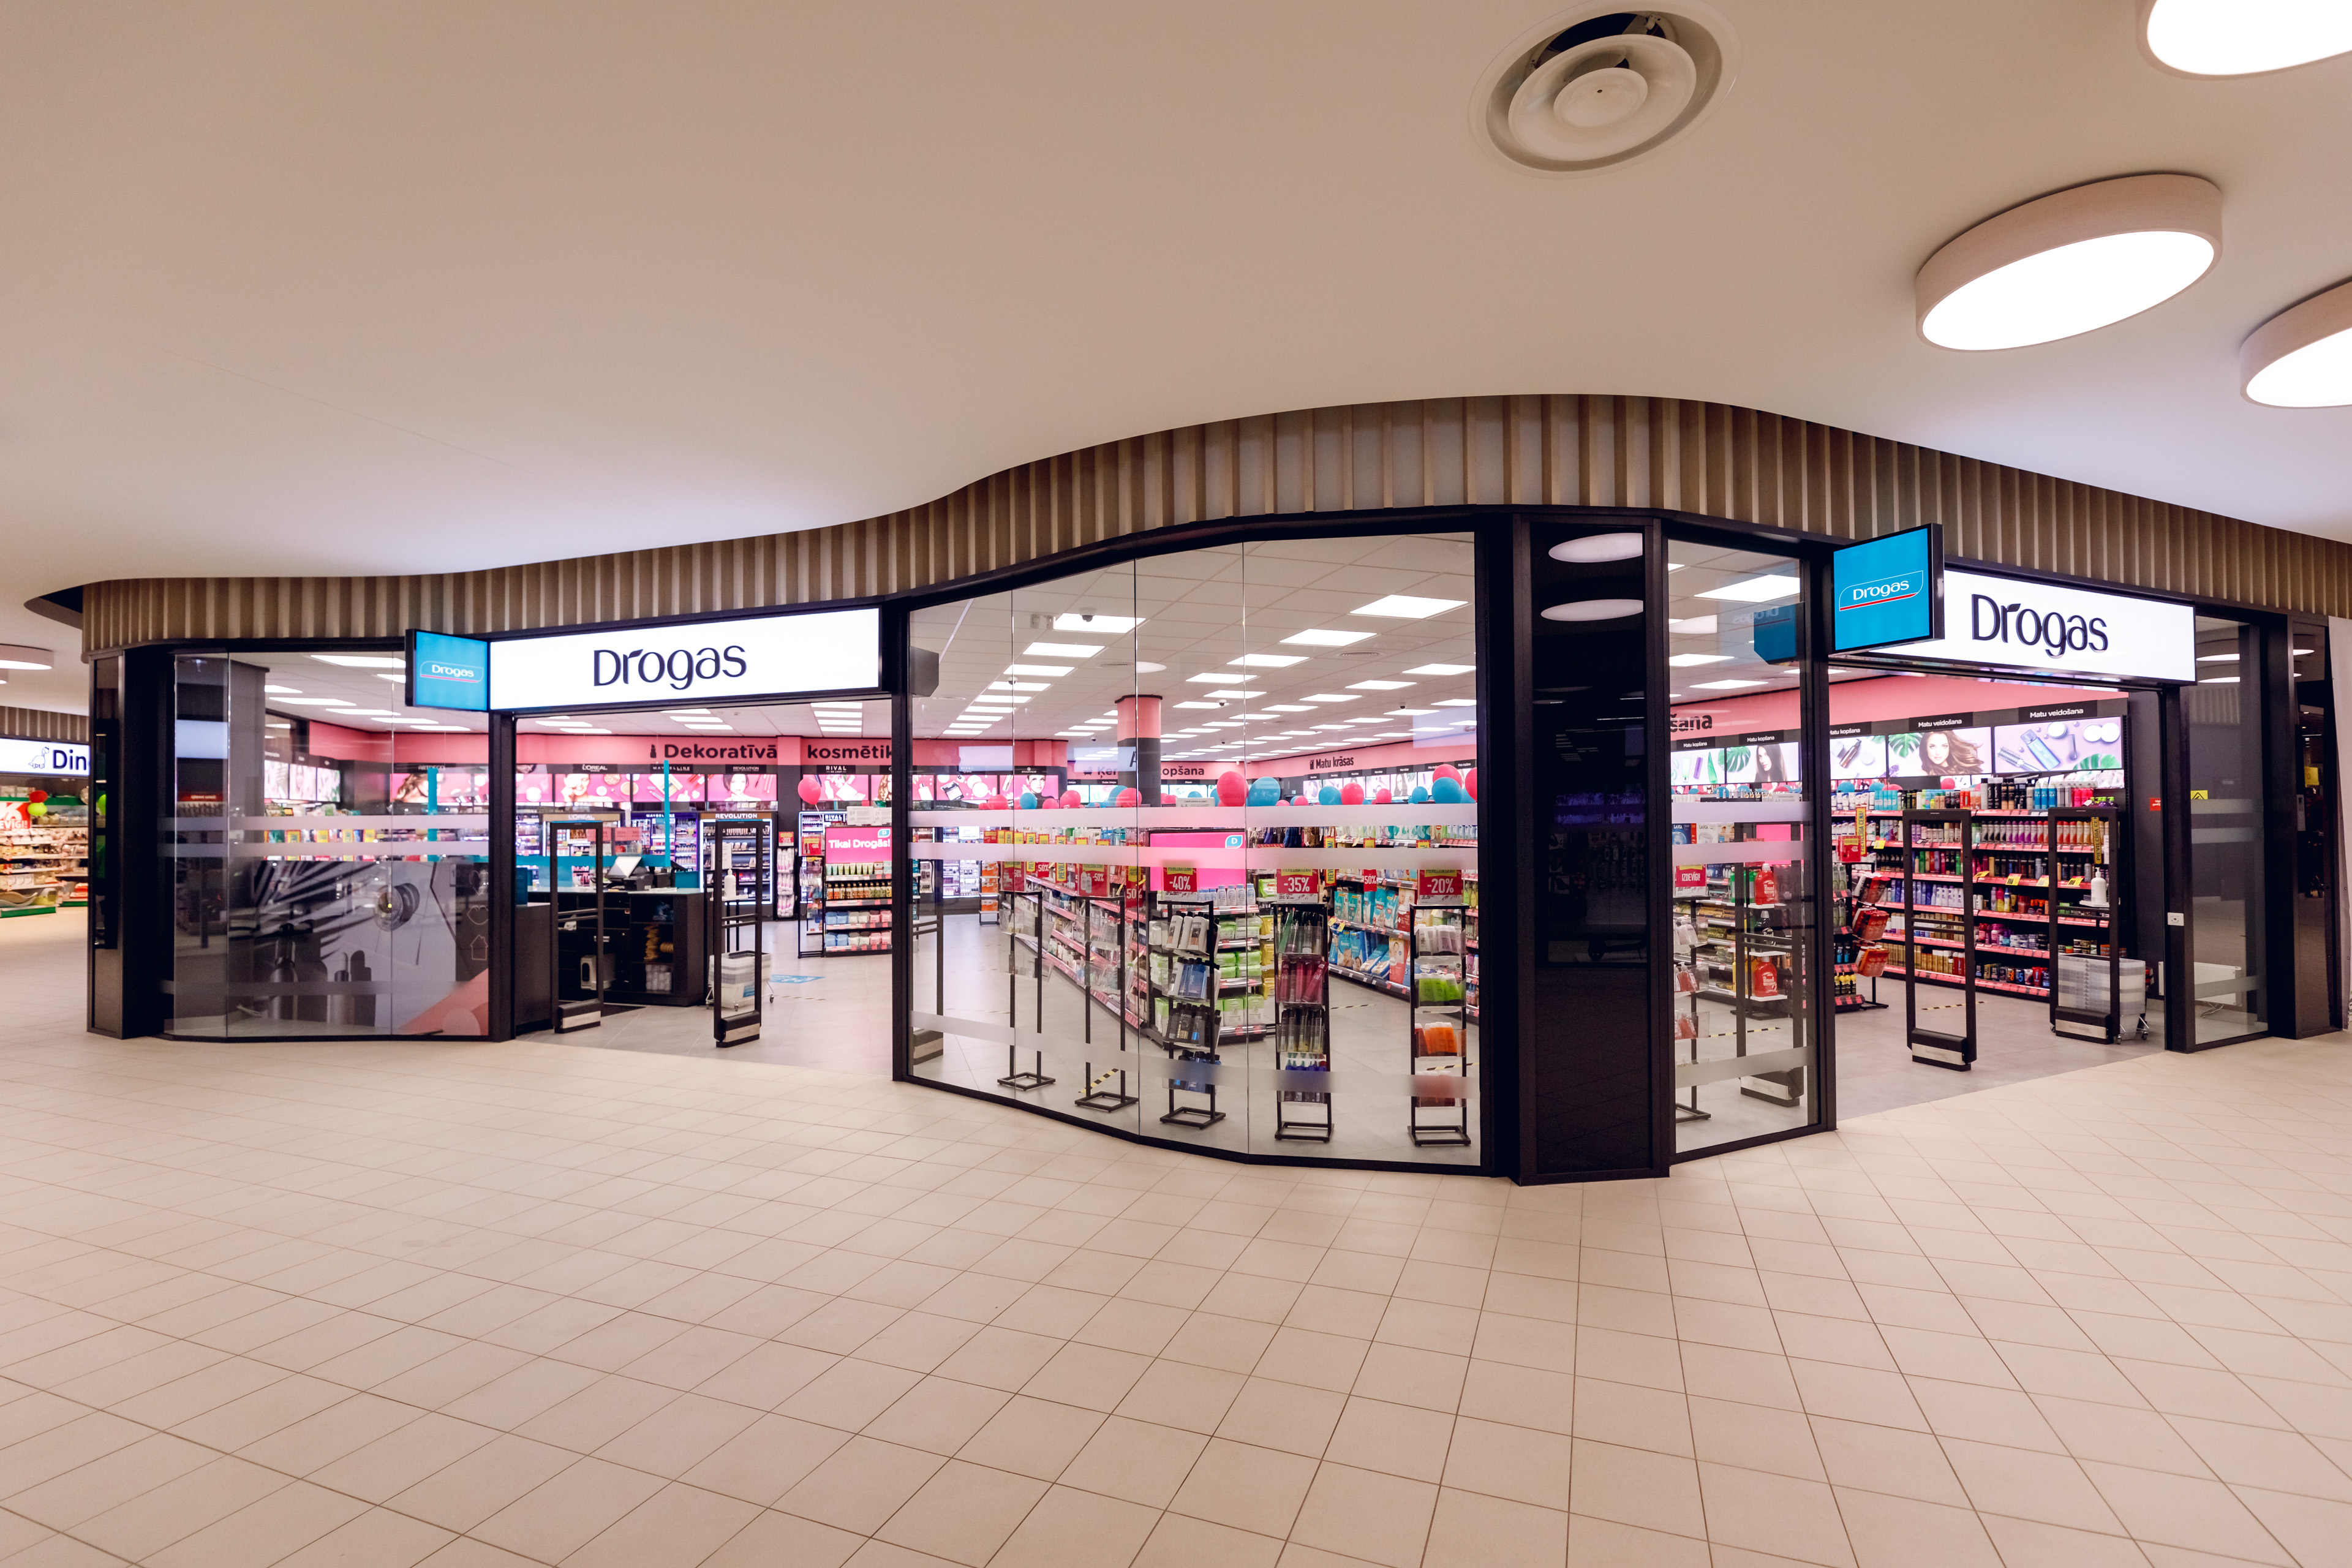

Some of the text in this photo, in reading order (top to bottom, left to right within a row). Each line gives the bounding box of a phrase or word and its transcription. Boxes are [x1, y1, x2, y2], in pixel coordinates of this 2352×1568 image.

[1853, 580, 1910, 600] Drogas
[1971, 594, 2109, 659] Drogas
[432, 664, 474, 677] Drogas
[593, 645, 747, 690] Drogas
[2048, 707, 2084, 717] veidošana
[1670, 714, 1713, 733] šana
[664, 744, 892, 759] Dekoratīvā kosmētik
[53, 748, 90, 771] Din
[1316, 756, 1354, 769] Matu krāsas
[1097, 765, 1205, 779] Ķer opšana
[0, 818, 28, 829] EVĪGI!
[828, 839, 891, 849] Tikai Drogās!
[1093, 873, 1104, 882] -50%
[1169, 875, 1191, 891] -40%
[1283, 876, 1310, 892] -35%
[1681, 872, 1701, 881] IZDEVĪGI!
[1427, 878, 1455, 894] -20%
